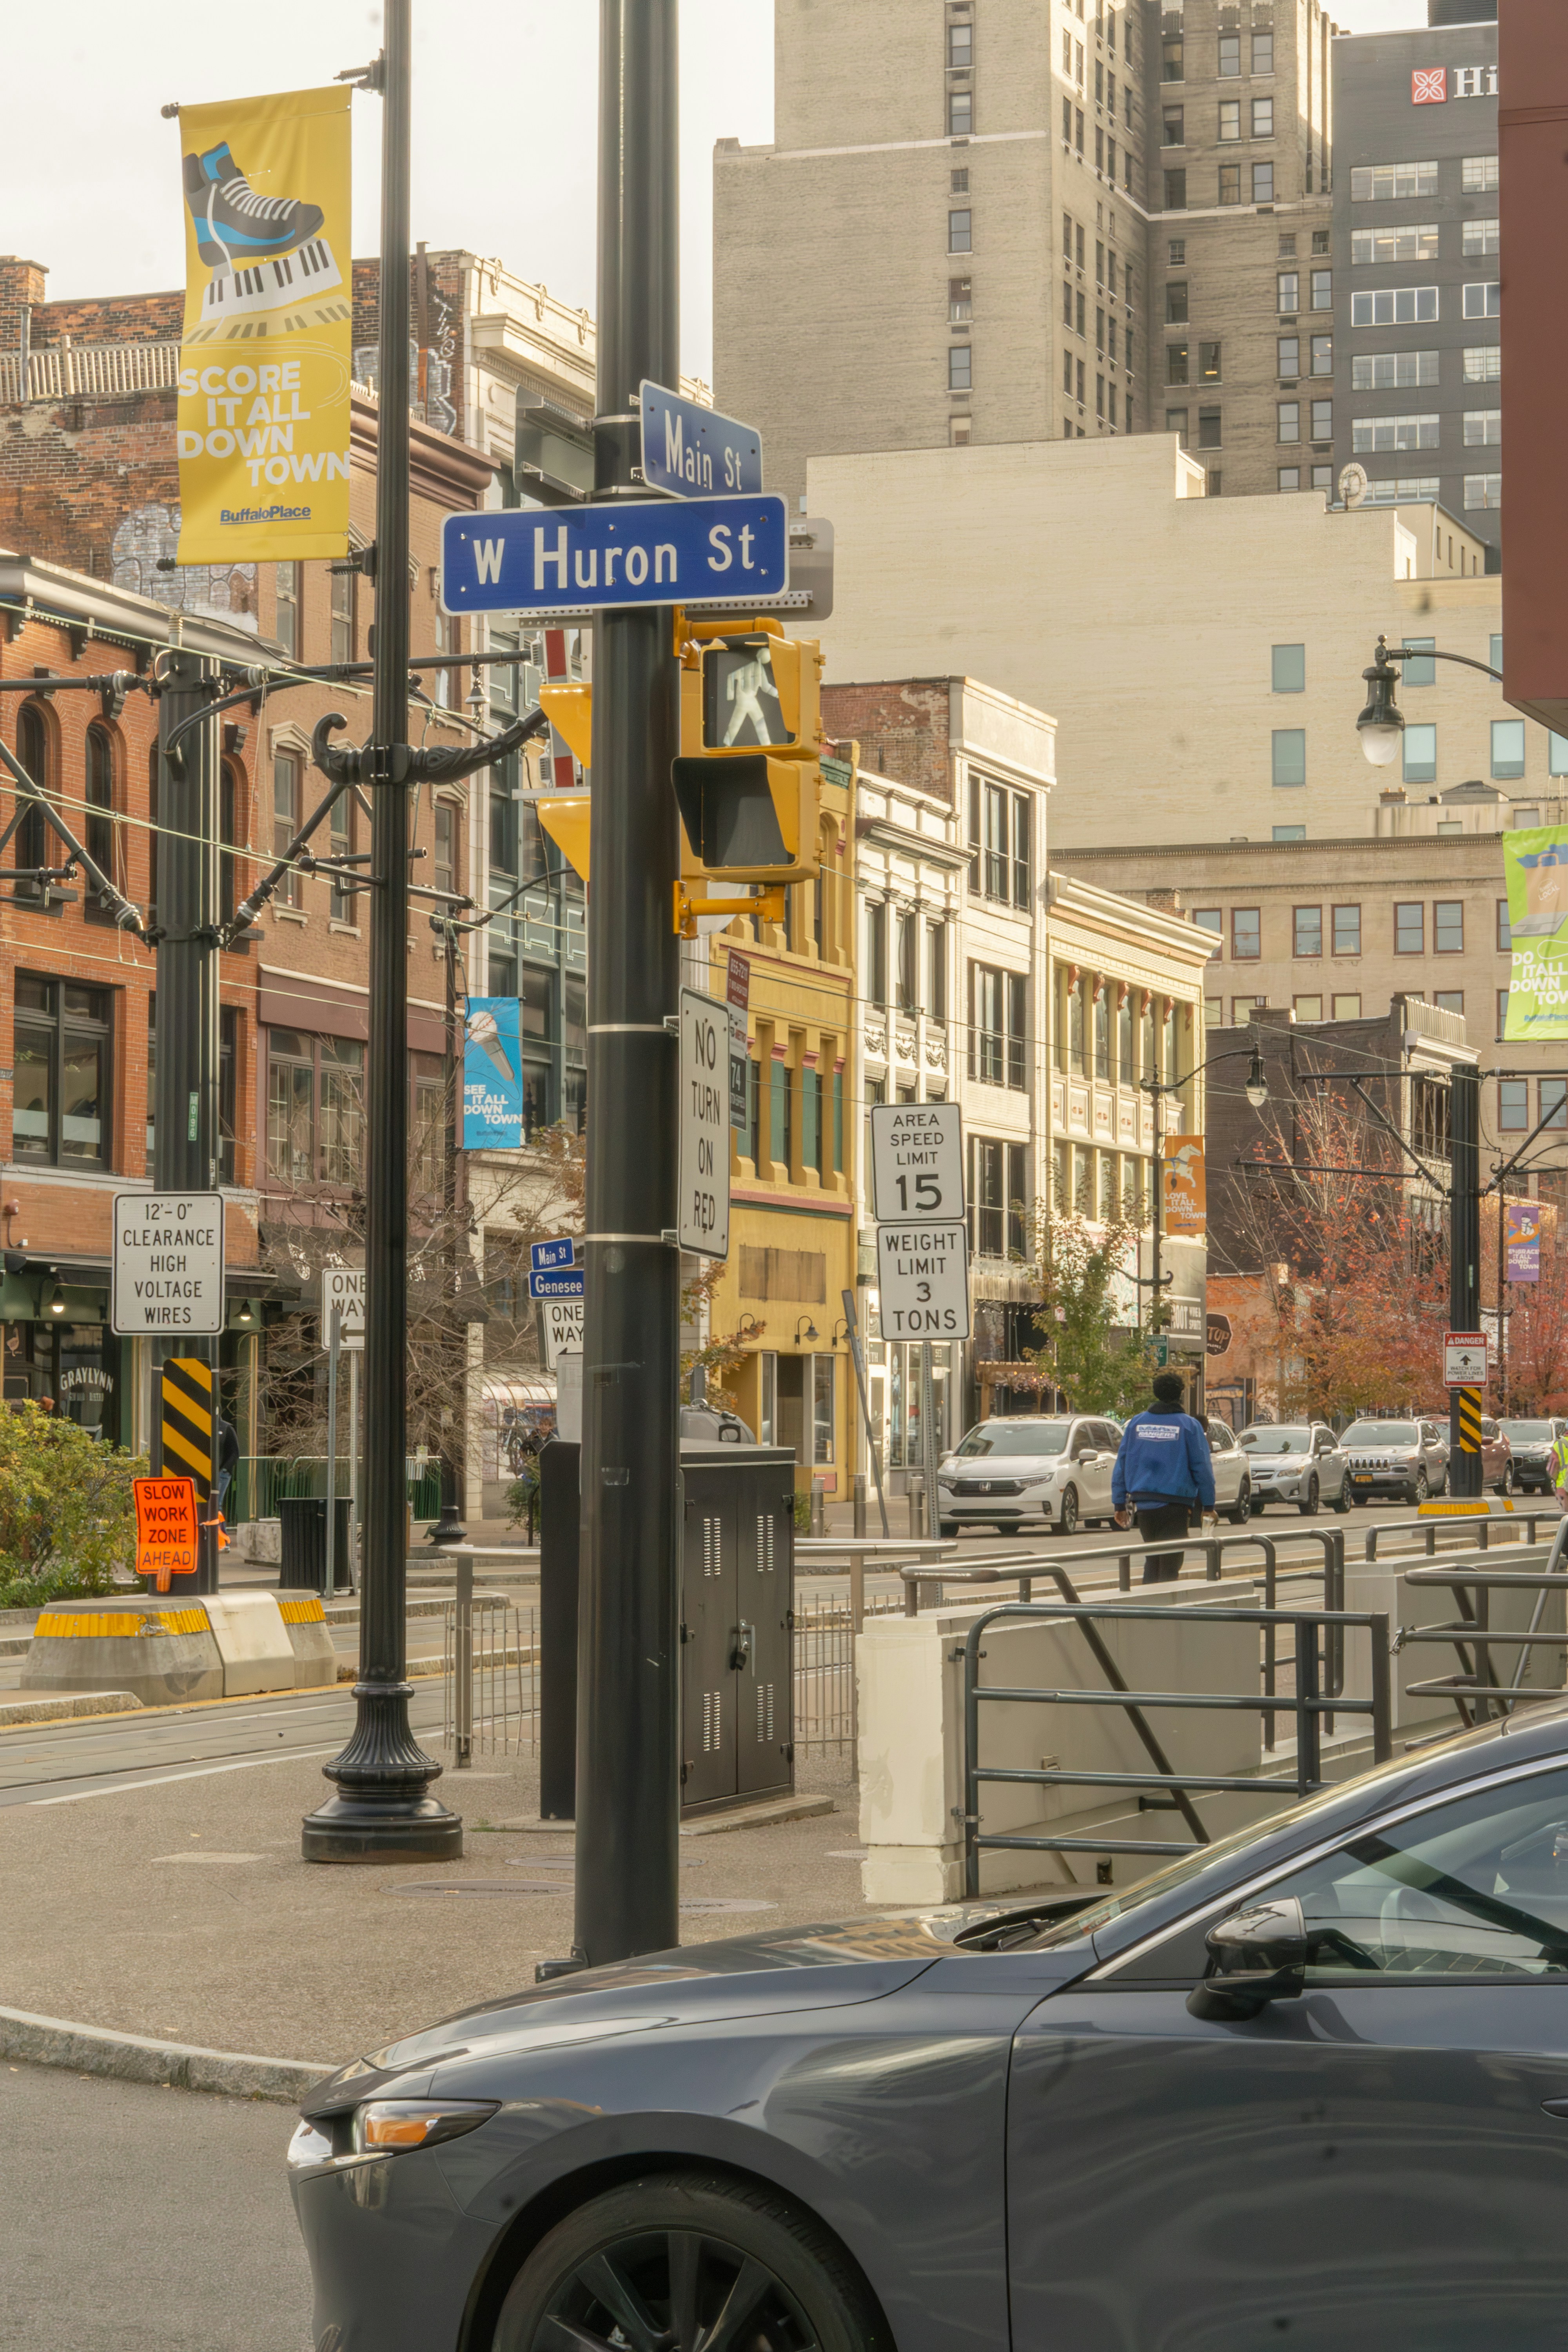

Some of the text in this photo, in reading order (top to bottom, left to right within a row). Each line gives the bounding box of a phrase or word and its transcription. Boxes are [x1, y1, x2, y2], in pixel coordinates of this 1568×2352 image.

[178, 361, 300, 396] SCORE
[207, 392, 310, 426] IT ALL
[177, 424, 293, 459] DOWN
[665, 409, 742, 490] Main St
[247, 451, 350, 486] TOWN
[220, 506, 311, 522] BuffaloPlace
[473, 524, 754, 590] W Huron St
[1512, 951, 1534, 966] DO
[1522, 962, 1568, 978] IT ALL
[1509, 976, 1560, 993] DOWN
[696, 1019, 715, 1070] NO
[464, 1085, 486, 1094] SEE
[472, 1094, 509, 1104] IT ALL
[691, 1080, 720, 1126] TURN
[463, 1104, 503, 1115] DOWN
[484, 1114, 523, 1124] TOWN
[893, 1114, 940, 1127] AREA
[891, 1132, 944, 1146] SPEED
[699, 1137, 713, 1177] ON
[897, 1152, 938, 1165] LIMIT
[896, 1174, 942, 1211] 15
[694, 1190, 715, 1230] RED
[123, 1229, 214, 1246] CLEARANCE
[886, 1233, 956, 1251] WEIGHT
[151, 1256, 186, 1272] HIGH
[538, 1247, 566, 1265] Main St
[898, 1258, 946, 1275] LIMIT
[135, 1281, 202, 1298] VOLTAGE
[535, 1275, 582, 1294] Genesee
[916, 1282, 931, 1302] 3
[145, 1307, 191, 1324] WIRES
[552, 1305, 584, 1322] ONE
[893, 1309, 956, 1331] TONS
[60, 1367, 114, 1393] GRAYLYNN
[144, 1485, 184, 1500] SLOW
[144, 1507, 188, 1521] WORK
[149, 1529, 186, 1543] ZONE
[142, 1551, 191, 1565] AHEAD
